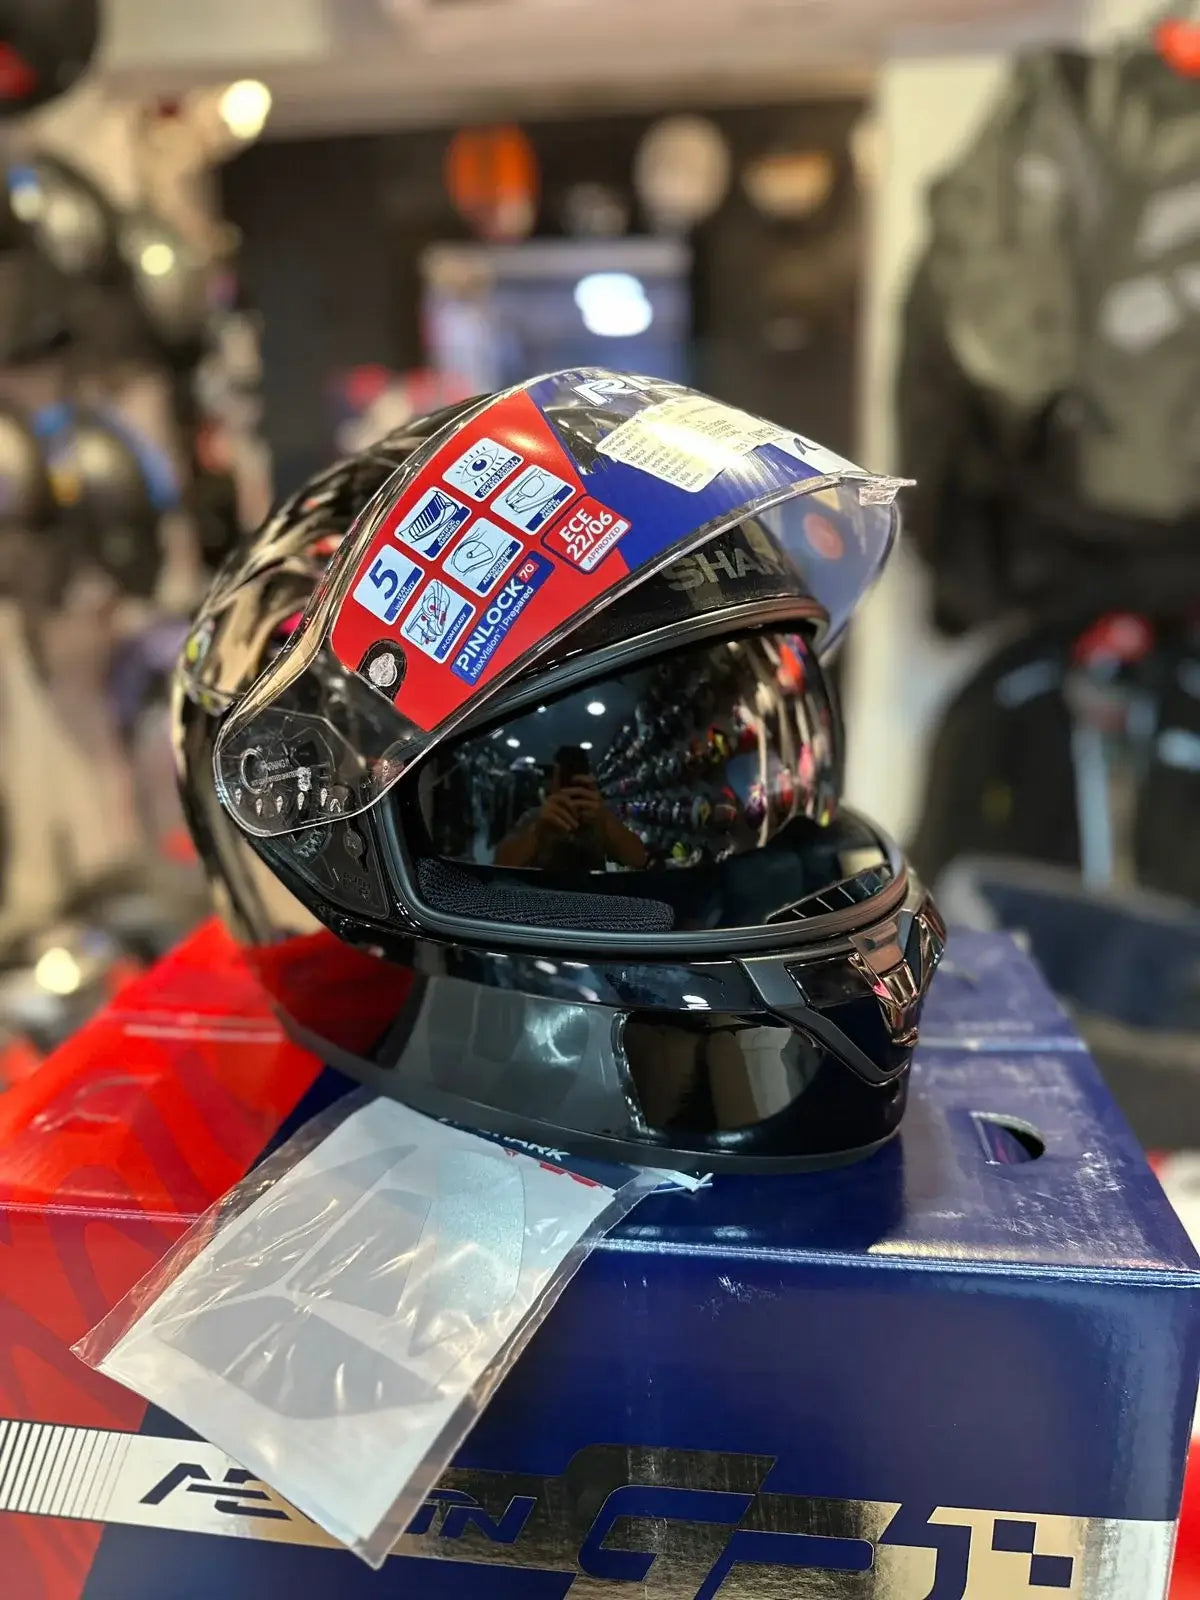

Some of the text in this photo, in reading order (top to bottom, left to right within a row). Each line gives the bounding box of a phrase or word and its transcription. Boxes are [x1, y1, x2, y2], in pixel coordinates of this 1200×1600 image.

[489, 476, 500, 488] BEST
[499, 459, 519, 477] QUALITY
[539, 498, 555, 514] SHARK
[541, 506, 554, 519] EASY
[436, 519, 455, 541] ANTIFOG
[437, 518, 461, 546] SUNSHIELD
[558, 507, 593, 542] ECE
[564, 510, 613, 560] 22/06
[586, 526, 621, 562] APPROVED
[369, 559, 399, 600] 5
[481, 546, 512, 584] AERODYNAMIC
[491, 557, 509, 578] PROFILE
[394, 579, 415, 610] WARRANTY
[396, 585, 407, 599] YEAR
[502, 585, 535, 626] Prepared
[452, 612, 467, 631] READY
[456, 562, 535, 670] PINLOCK 70
